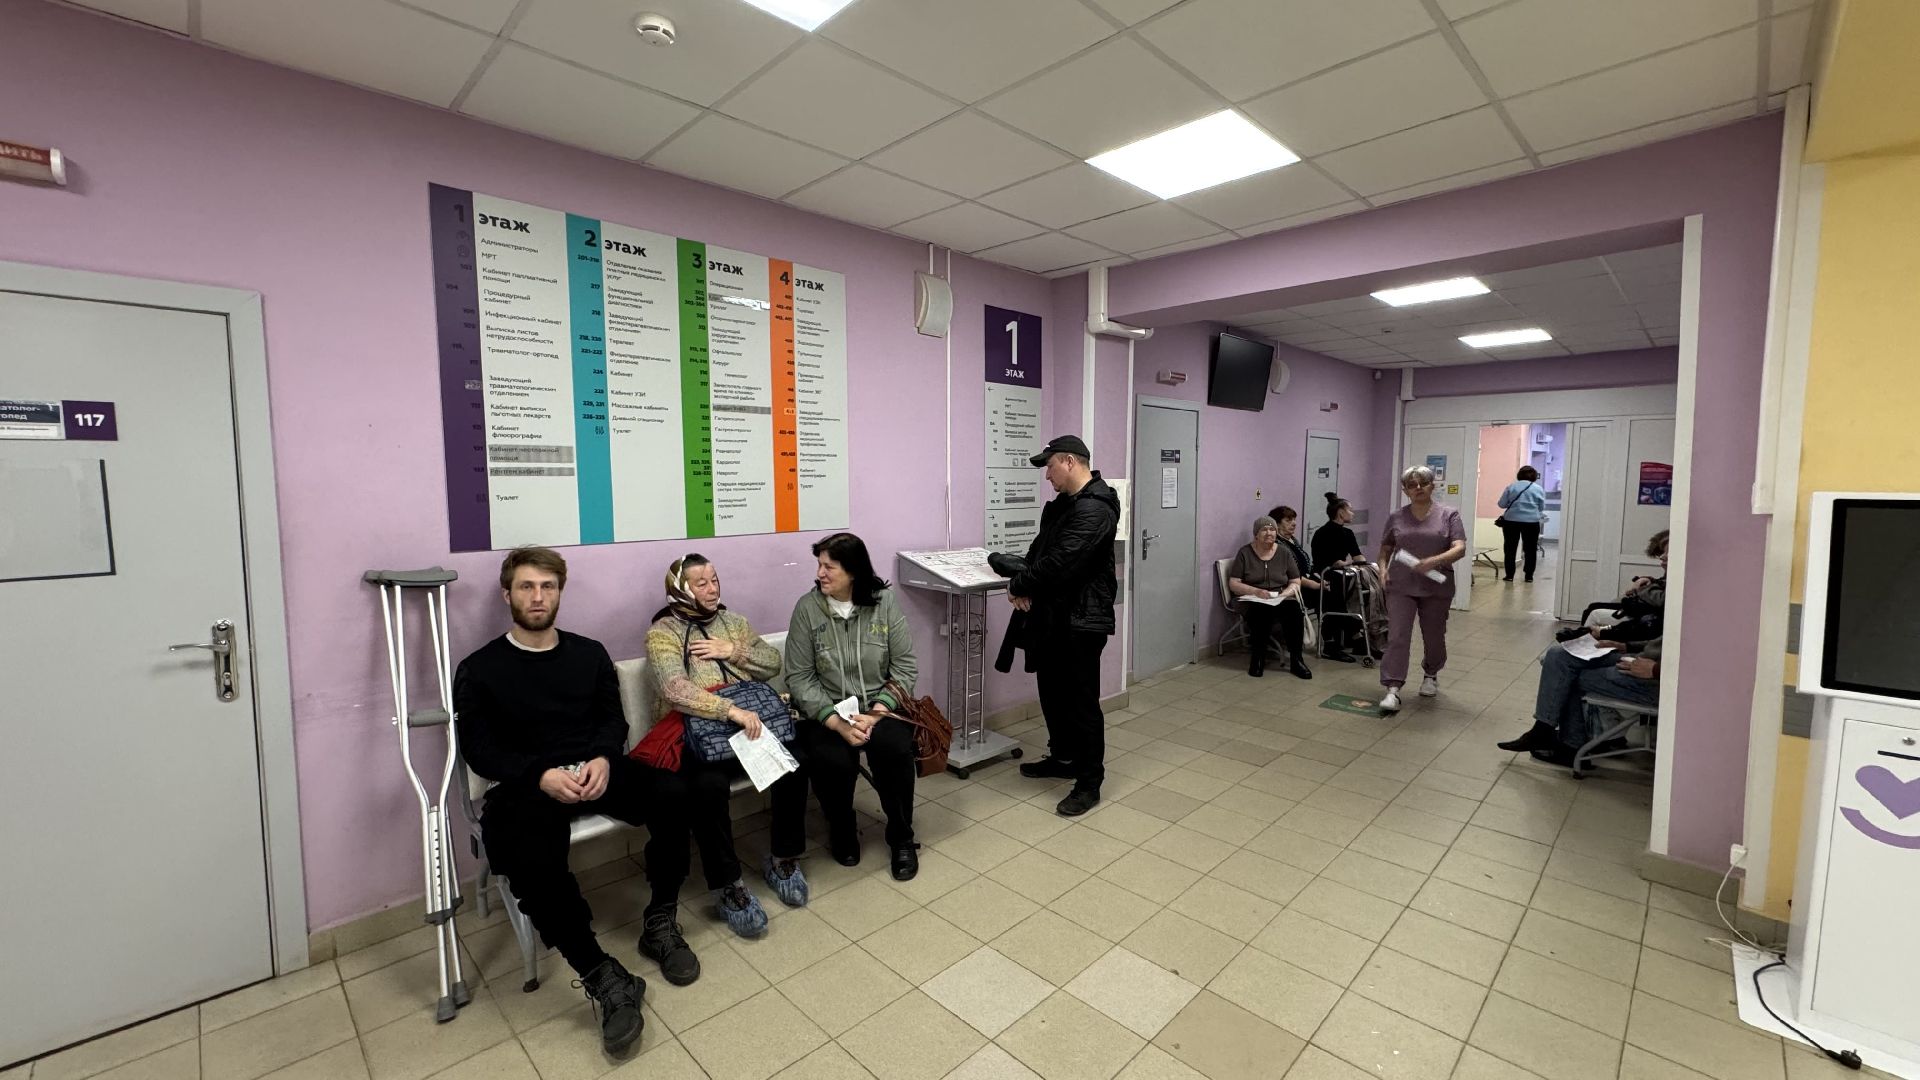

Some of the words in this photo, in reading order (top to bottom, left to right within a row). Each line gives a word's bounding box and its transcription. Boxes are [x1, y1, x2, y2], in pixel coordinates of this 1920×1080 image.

[453, 203, 465, 224] 1
[478, 213, 531, 234] этаж
[584, 229, 597, 249] 2
[604, 239, 648, 258] этаж
[481, 252, 497, 261] МРТ
[692, 252, 703, 269] 3
[708, 260, 744, 276] этаж
[482, 266, 511, 278] Кабинет
[779, 271, 791, 286] 4
[795, 278, 825, 292] этаж
[483, 289, 531, 301] Процедурный
[486, 325, 515, 334] Выписка
[486, 333, 554, 345] нетрудоспособности
[1005, 320, 1018, 365] 1
[487, 346, 560, 360] Травматолог-ортопед
[610, 370, 633, 378] Кабинет
[1004, 368, 1025, 379] ЭТАЖ
[489, 390, 530, 398] отделением
[610, 389, 633, 397] Кабинет
[74, 413, 105, 427] 117
[491, 432, 542, 440] флюорографии
[496, 494, 519, 502] Туалет
